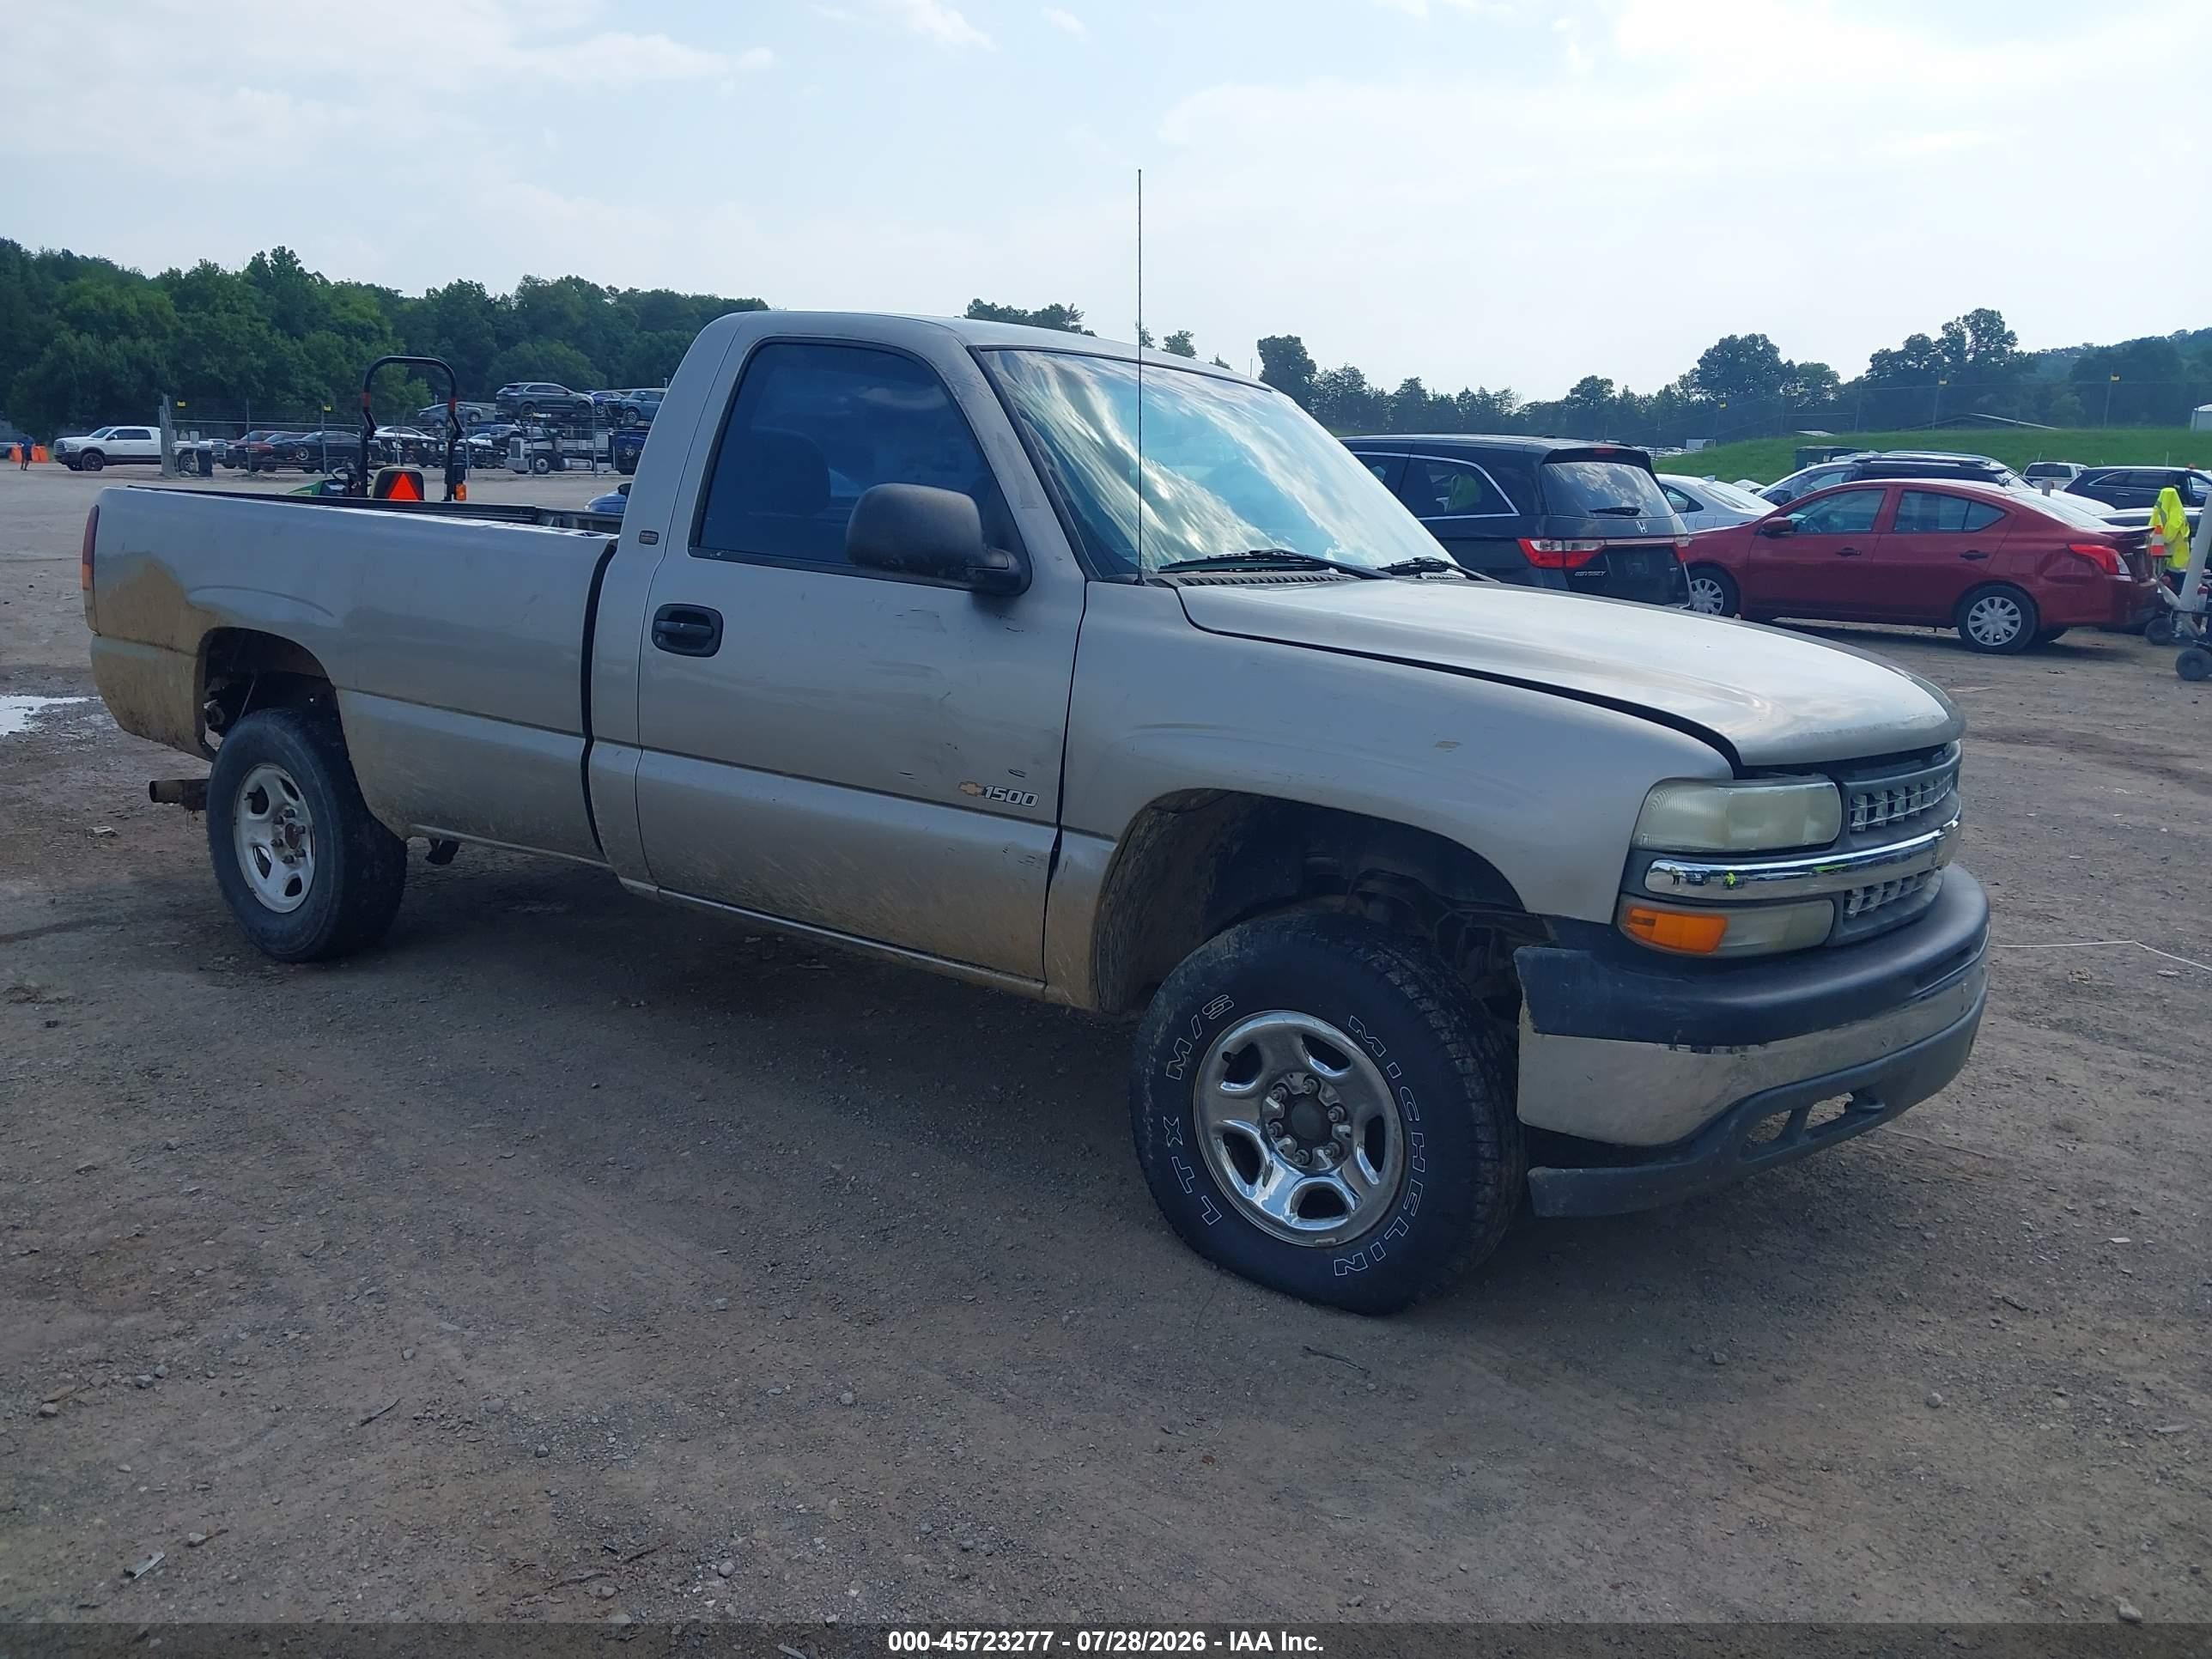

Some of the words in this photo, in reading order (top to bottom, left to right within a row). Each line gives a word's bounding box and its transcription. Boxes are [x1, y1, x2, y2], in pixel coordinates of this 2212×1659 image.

[985, 785, 1039, 807] 1500
[1166, 994, 1235, 1081] M/S
[1164, 1116, 1222, 1227] LTX
[1334, 1015, 1429, 1277] MICHELIN
